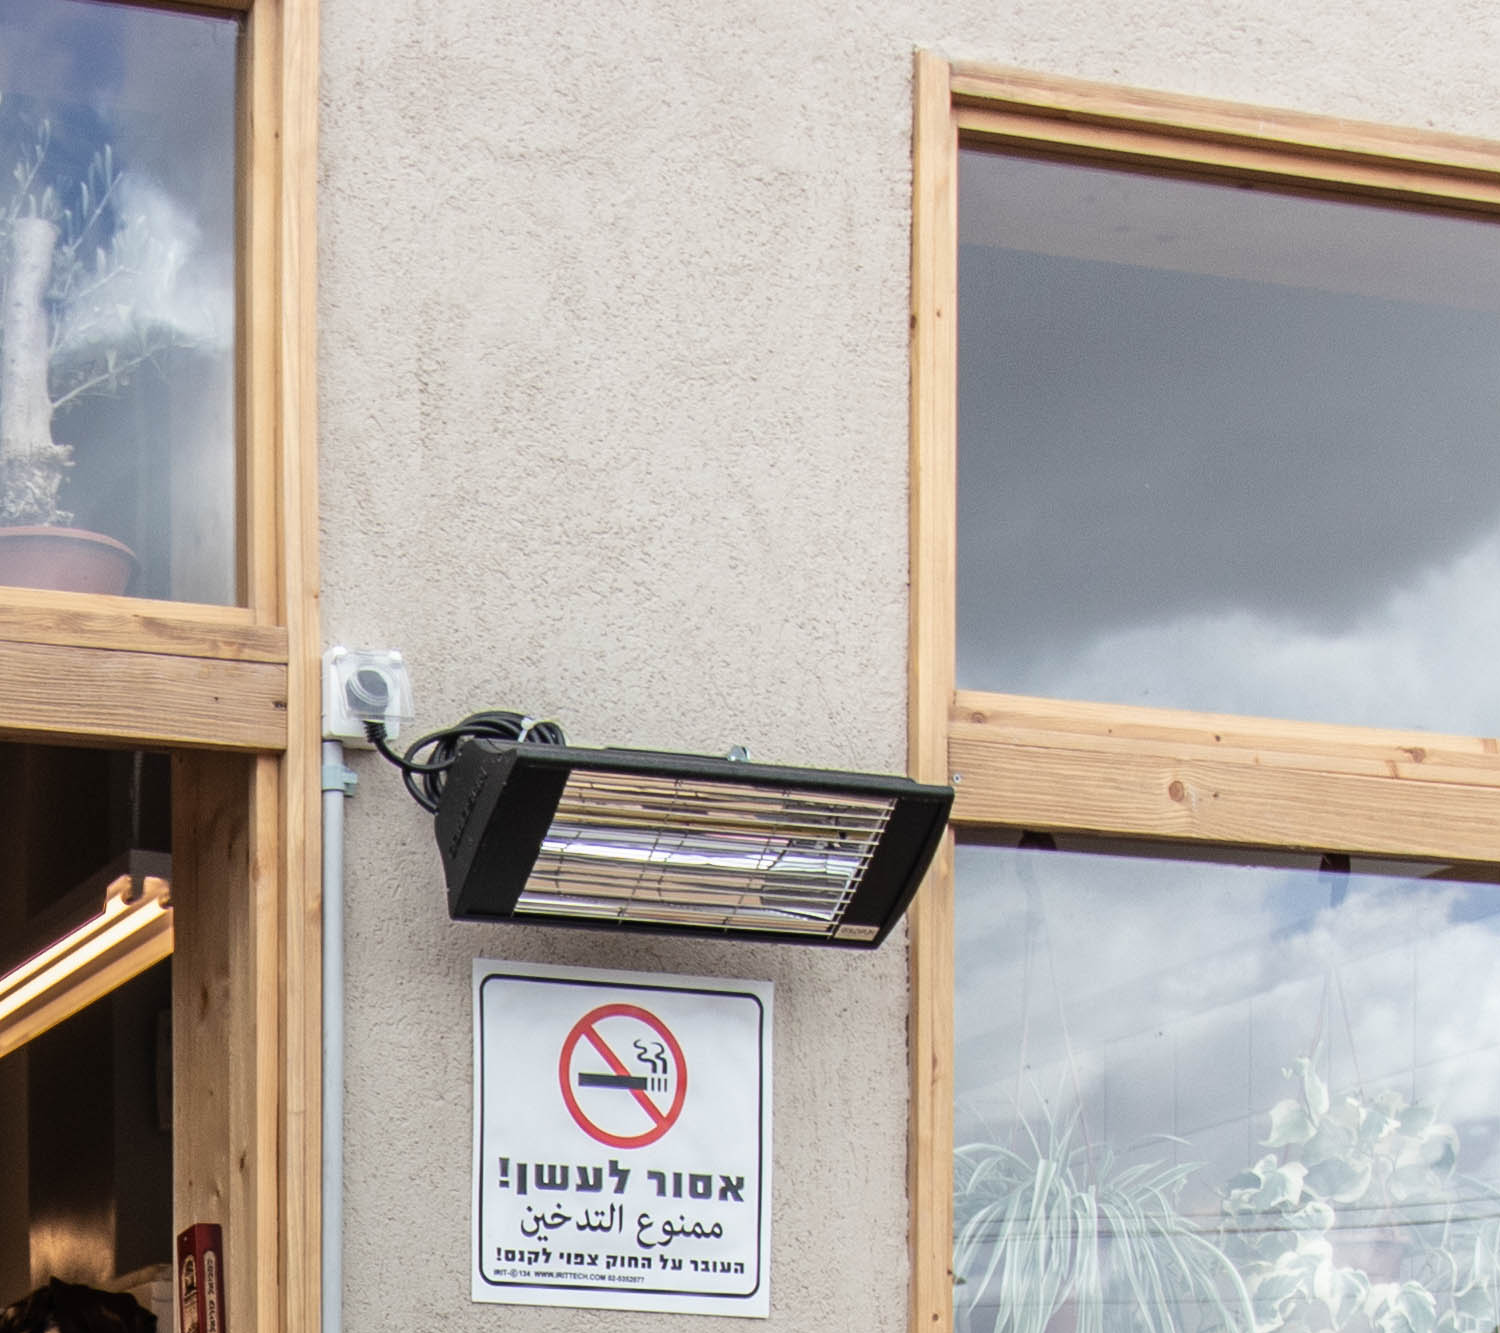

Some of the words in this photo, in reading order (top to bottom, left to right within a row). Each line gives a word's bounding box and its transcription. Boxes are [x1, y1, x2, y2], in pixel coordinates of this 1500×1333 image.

[498, 1156, 631, 1195] לעשן!
[646, 1169, 745, 1202] אסור
[520, 1202, 624, 1242] التدخين
[635, 1212, 724, 1249] ممنوع
[496, 1247, 552, 1265] לקנס!
[558, 1251, 599, 1266] צפוי
[605, 1254, 652, 1269] החוק
[659, 1254, 683, 1271] על
[690, 1259, 745, 1274] העובר
